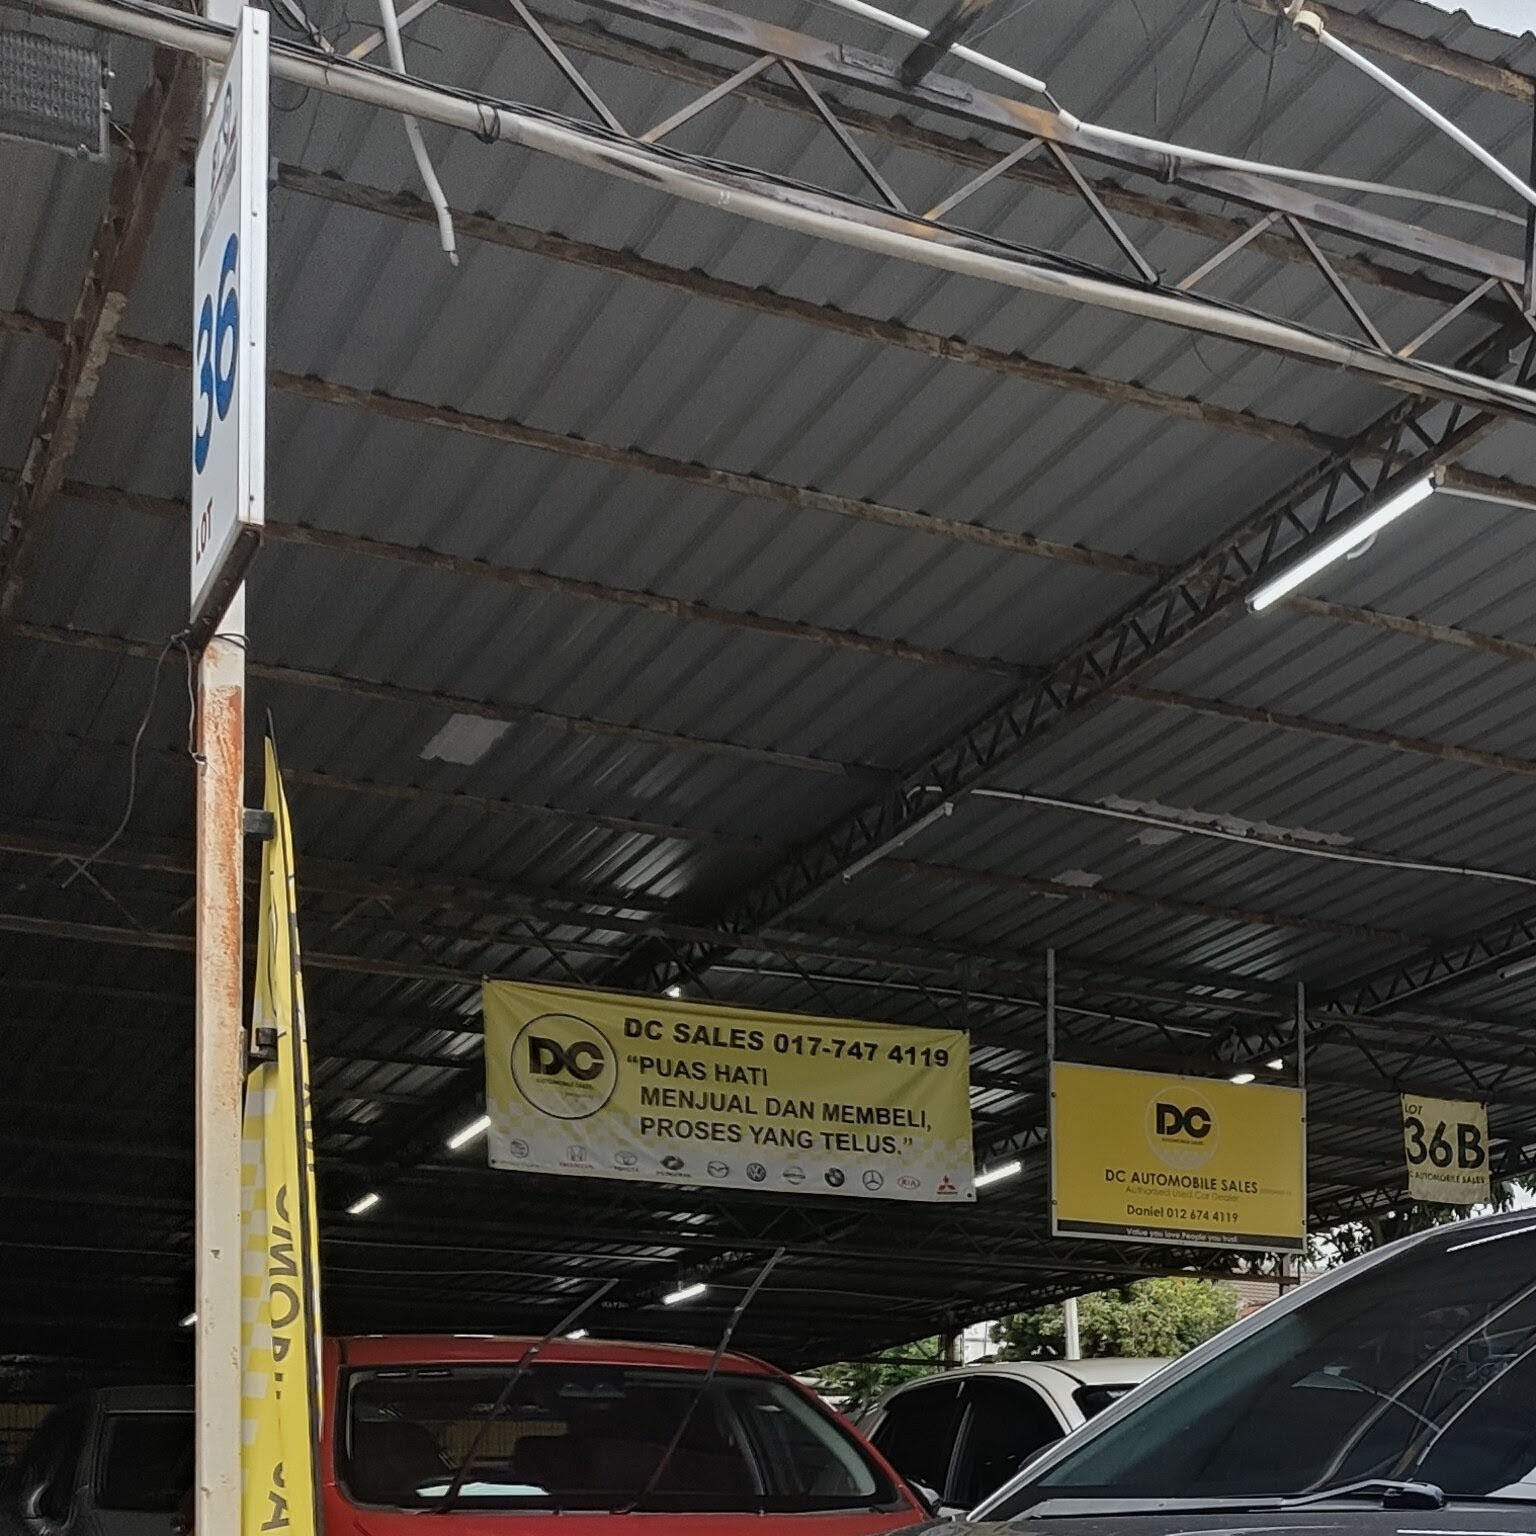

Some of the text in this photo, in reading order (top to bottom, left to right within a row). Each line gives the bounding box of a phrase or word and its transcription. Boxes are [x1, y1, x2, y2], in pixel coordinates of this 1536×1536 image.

[195, 233, 238, 476] 36
[196, 497, 214, 565] LOT
[528, 1036, 604, 1081] DC
[624, 1017, 949, 1067] DC SALES 017-747 4119
[714, 1063, 768, 1086] HATI
[641, 1086, 931, 1132] MENJUAL DAN MEMBELI,
[1156, 1103, 1211, 1138] DC
[1405, 1104, 1423, 1114] LOT
[640, 1116, 741, 1142] PROSES
[749, 1125, 813, 1148] YANG
[1404, 1116, 1485, 1168] 36B
[1105, 1169, 1126, 1182] DC
[1131, 1172, 1217, 1190] AUTOMOBILE
[1221, 1179, 1258, 1193] SALES
[1462, 1175, 1485, 1184] SALES
[1127, 1205, 1239, 1222] Daniel 012 674 4119
